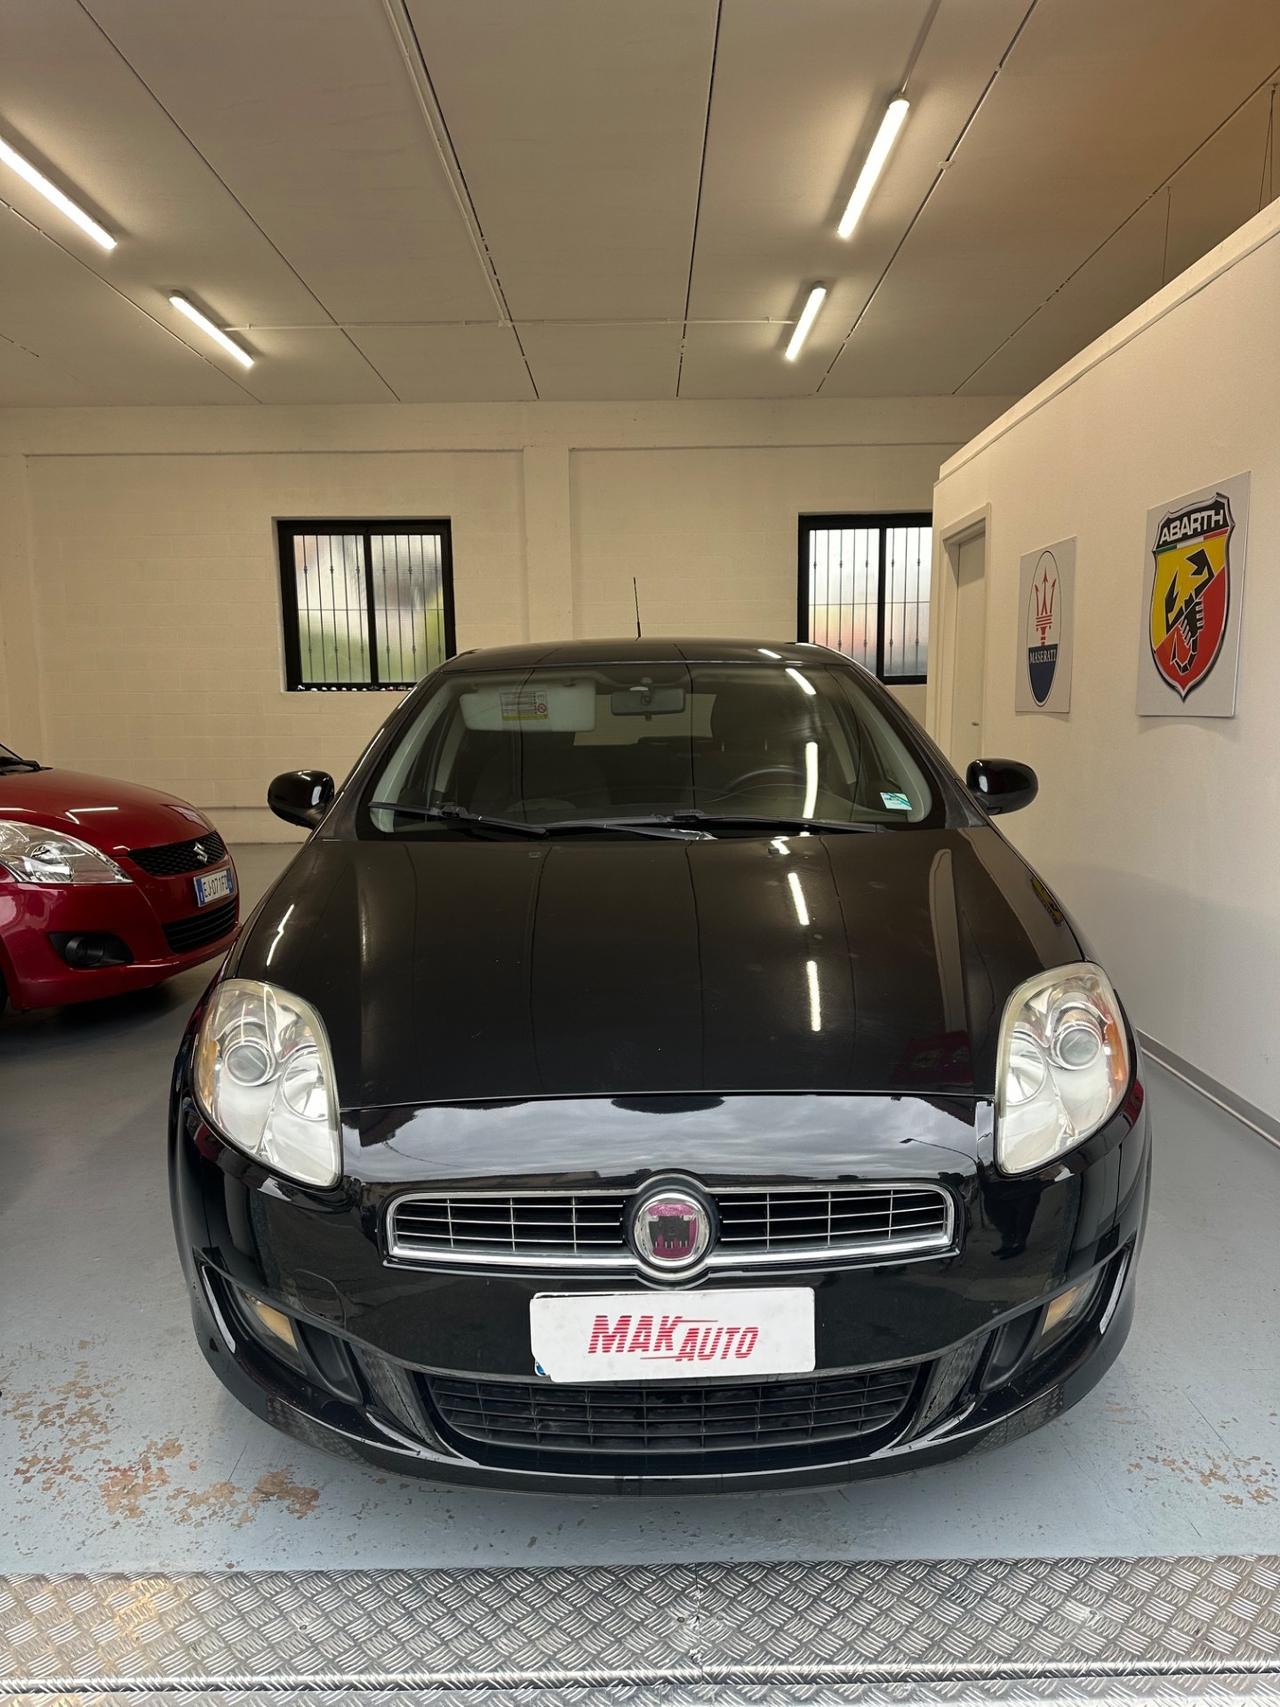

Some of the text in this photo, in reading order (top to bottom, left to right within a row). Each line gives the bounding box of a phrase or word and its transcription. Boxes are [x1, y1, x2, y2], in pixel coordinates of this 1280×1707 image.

[1159, 509, 1224, 544] ABARTH
[1029, 649, 1057, 664] MASERATI
[588, 1315, 759, 1361] MAK AUTO
